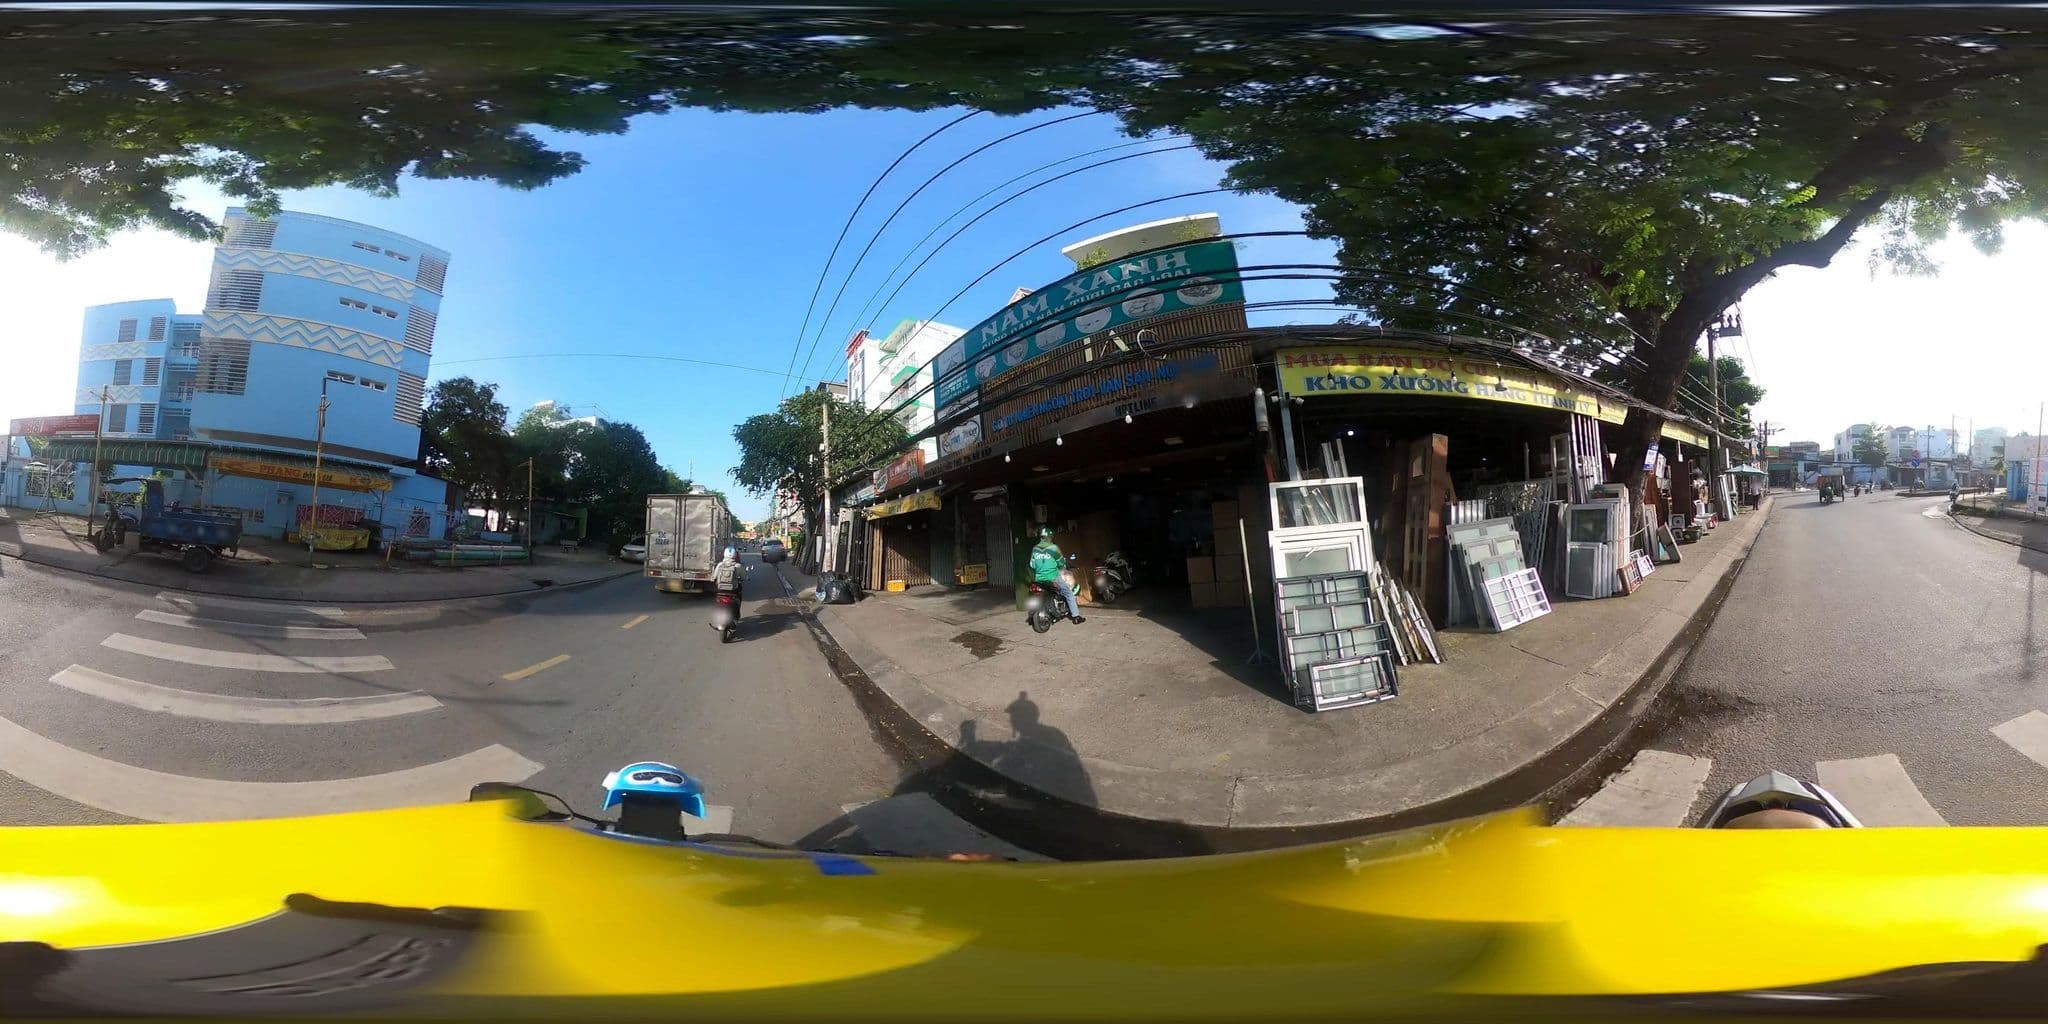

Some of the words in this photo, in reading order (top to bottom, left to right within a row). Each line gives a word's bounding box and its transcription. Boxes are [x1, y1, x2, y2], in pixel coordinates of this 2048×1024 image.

[1062, 251, 1190, 301] XANH
[1284, 354, 1350, 369] MUA
[1304, 374, 1372, 392] KHO
[1533, 392, 1577, 412] THANH
[1034, 552, 1052, 560] Grab
